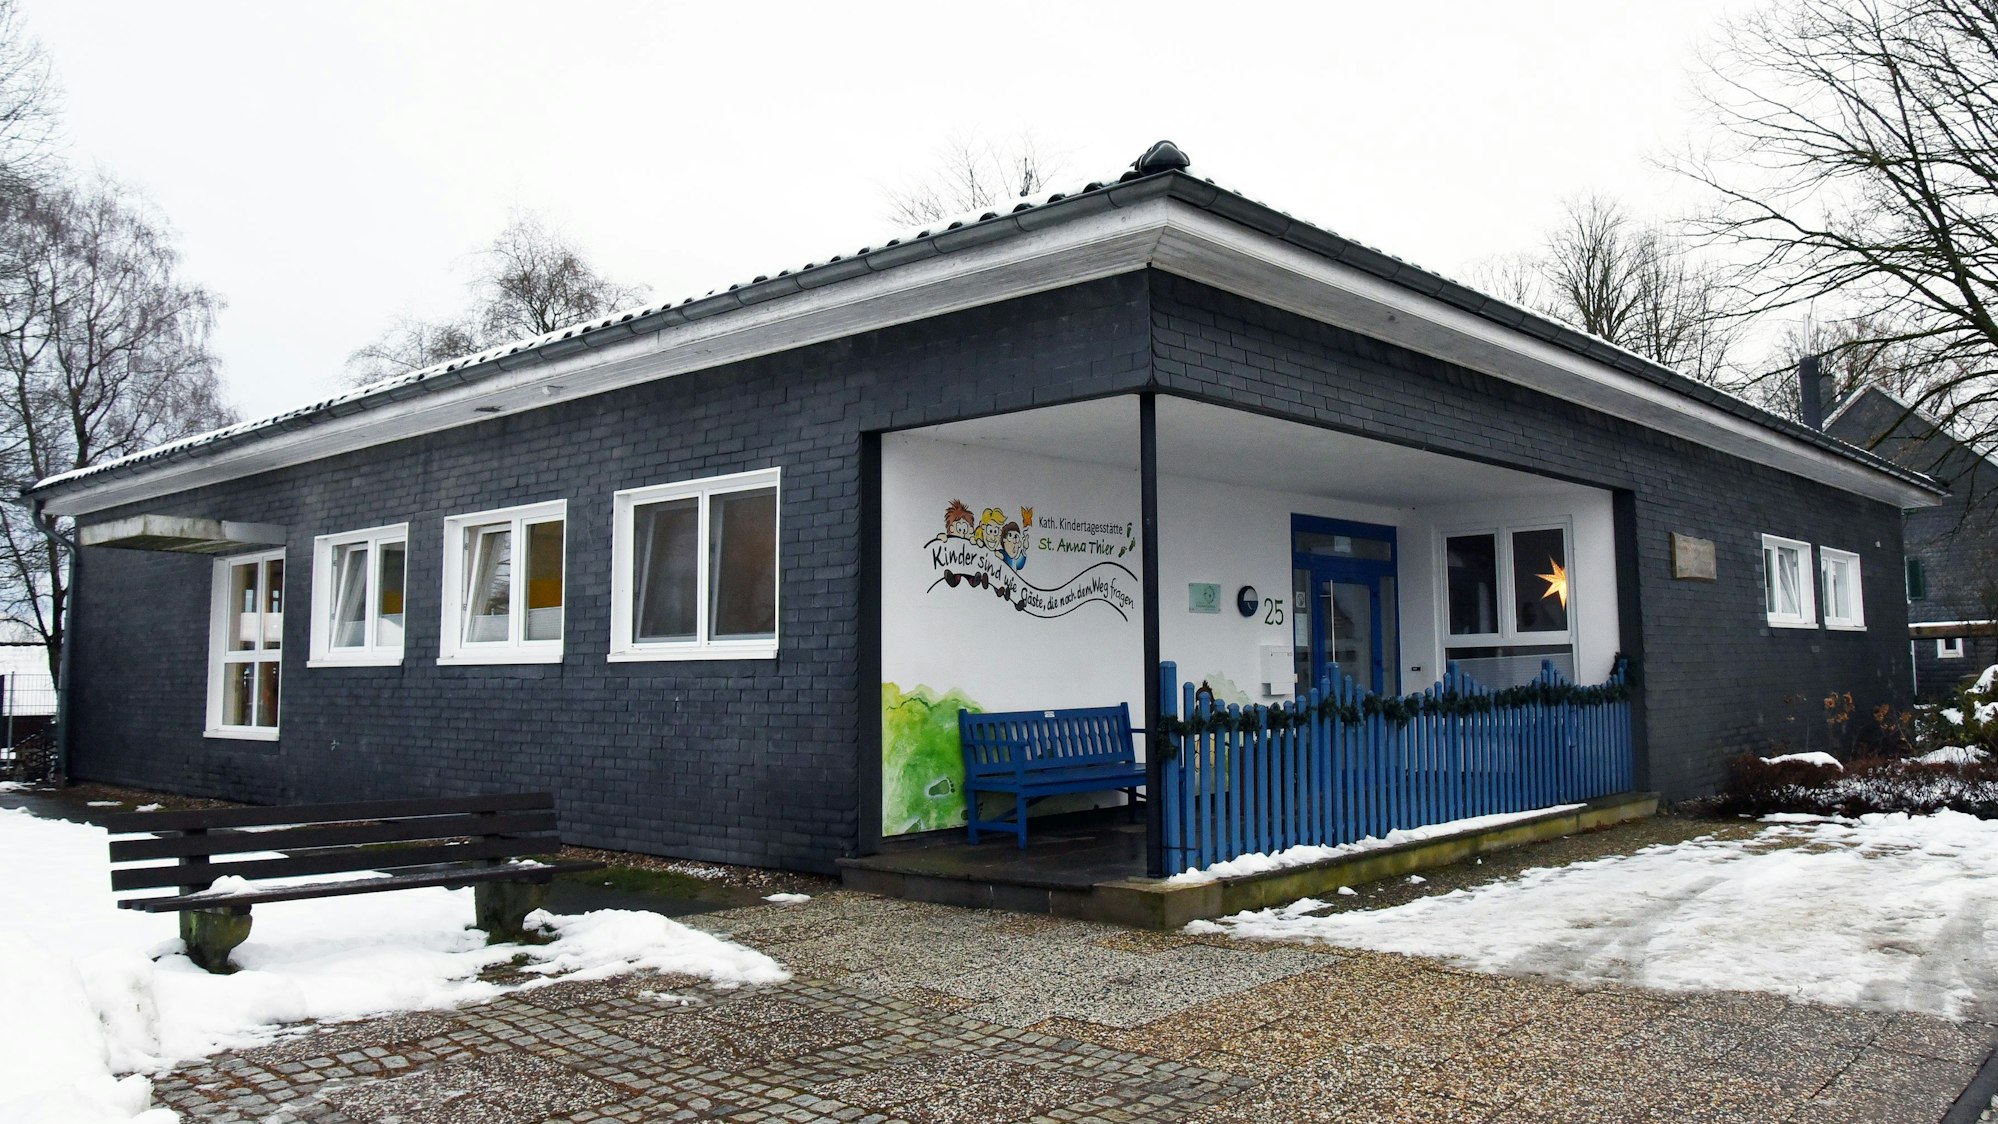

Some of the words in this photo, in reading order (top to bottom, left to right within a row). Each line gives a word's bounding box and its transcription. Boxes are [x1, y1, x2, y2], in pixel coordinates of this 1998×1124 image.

[1038, 516, 1058, 530] Kath.
[1059, 517, 1124, 536] Kindertagesstätte
[1038, 537, 1055, 551] St.
[1056, 537, 1087, 553] Anna
[1088, 539, 1115, 556] Thier
[932, 544, 978, 571] Kinder
[977, 553, 1002, 581] sind
[1003, 574, 1017, 593] wie
[1047, 595, 1058, 611] die
[1059, 588, 1077, 609] nach
[1077, 582, 1093, 599] dem
[1091, 576, 1109, 599] Weg
[1109, 577, 1135, 610] fragen
[1263, 597, 1284, 626] 25
